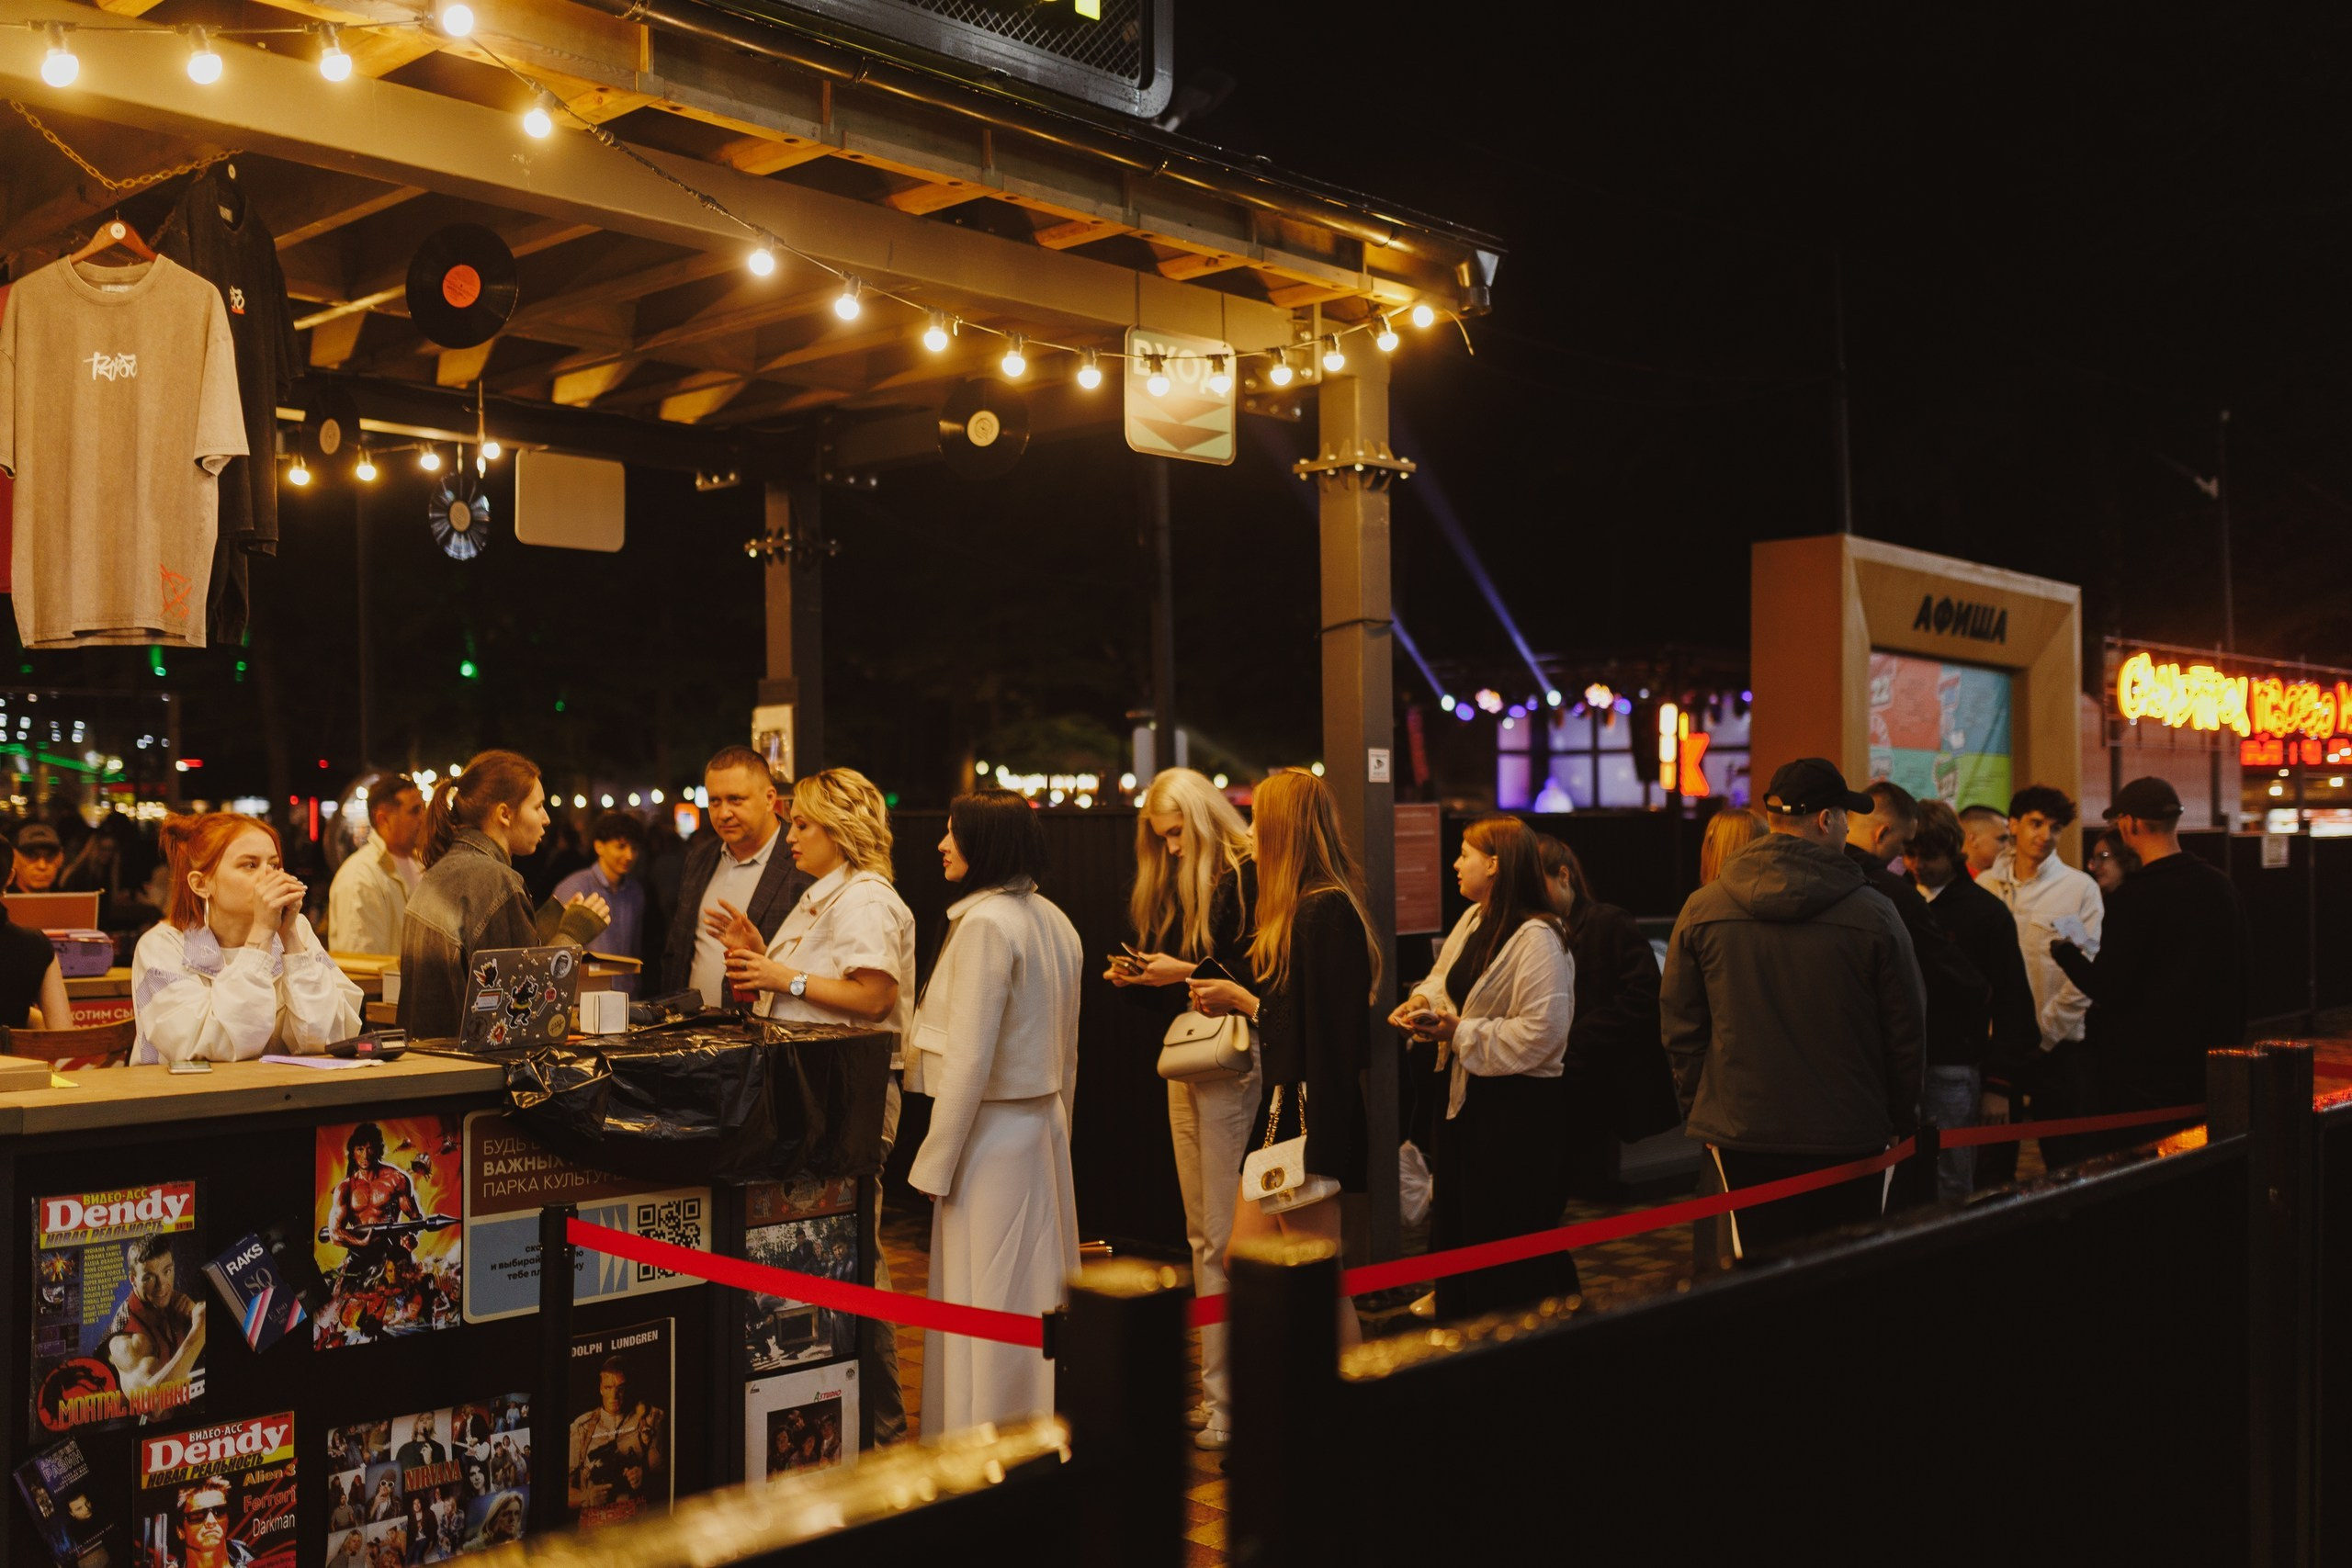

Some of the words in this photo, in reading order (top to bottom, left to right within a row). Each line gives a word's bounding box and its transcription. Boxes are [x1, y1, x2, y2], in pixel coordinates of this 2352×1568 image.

[1913, 593, 2007, 645] АФИША
[483, 1137, 526, 1156] БУДЬ
[483, 1179, 539, 1198] ПАРКА
[45, 1189, 189, 1233] Dendy
[46, 1230, 88, 1246] НОВАЯ
[91, 1221, 164, 1241] РЕАЛЬНОСТЬ
[226, 1243, 264, 1276] RAKS
[244, 1268, 277, 1297] SQ
[507, 1270, 529, 1280] тебе
[611, 1329, 659, 1350] LUNDGREN
[58, 1390, 127, 1428] MORTAL
[130, 1378, 192, 1416] KOMBAT
[147, 1422, 288, 1473] Dendy
[42, 1450, 84, 1482] РАЗИН
[147, 1467, 188, 1487] НОВАЯ
[190, 1452, 265, 1479] РЕАЛЬНОСТЬ
[243, 1469, 283, 1486] Alien
[285, 1463, 296, 1477] 3
[404, 1459, 462, 1492] NIRVANA
[243, 1483, 297, 1513] Ferrari
[253, 1514, 296, 1537] Darkman
